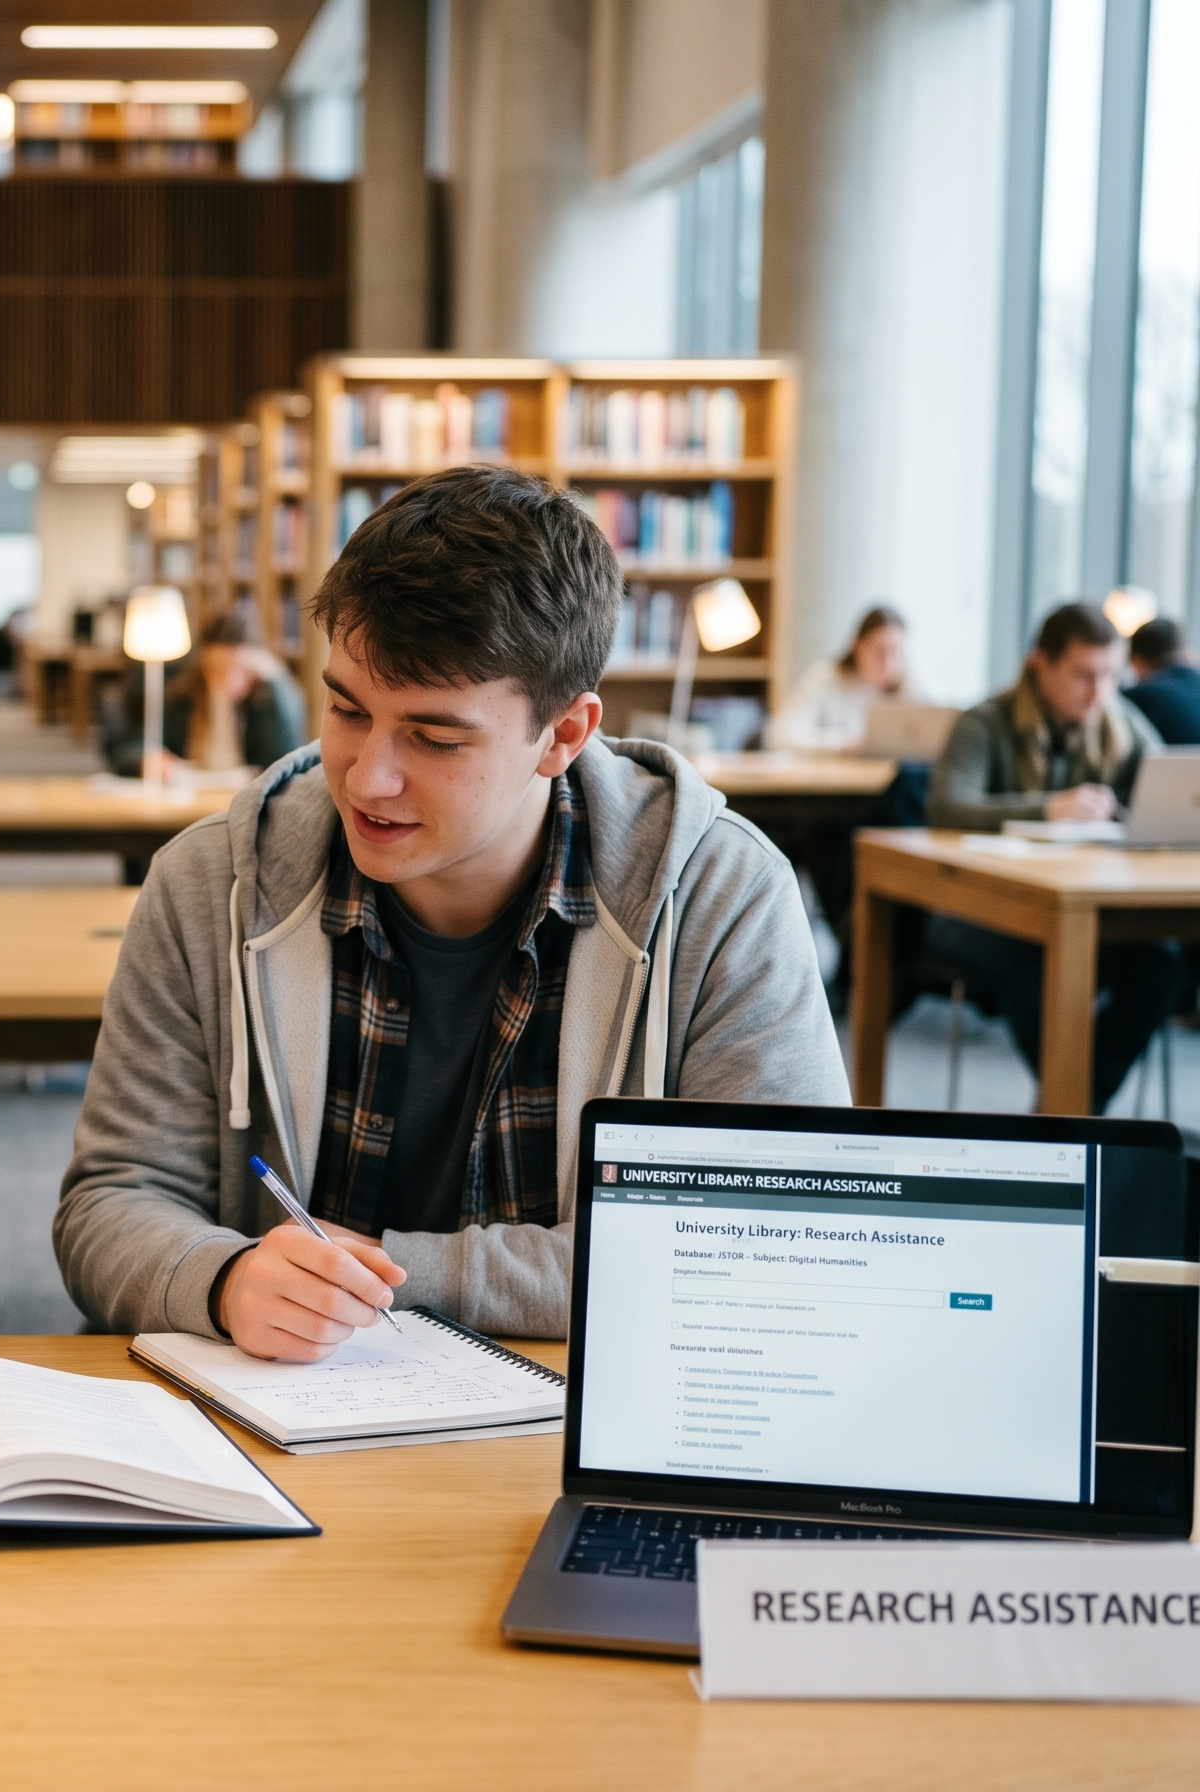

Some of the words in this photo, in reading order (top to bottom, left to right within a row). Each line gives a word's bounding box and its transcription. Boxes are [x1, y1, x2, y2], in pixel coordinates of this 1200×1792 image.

[622, 1169, 697, 1185] UNIVERSITY
[697, 1172, 753, 1188] LIBRARY:
[755, 1175, 822, 1191] RESEARCH
[823, 1178, 902, 1195] ASSISTANCE
[675, 1220, 745, 1239] University
[748, 1224, 801, 1242] Library:
[805, 1227, 867, 1242] Research
[870, 1230, 945, 1246] Assistance
[674, 1249, 715, 1260] Database:
[717, 1250, 744, 1260] JSTOR
[752, 1253, 787, 1264] Subject:
[788, 1254, 817, 1266] Digital
[818, 1256, 868, 1267] Humanities
[752, 1590, 955, 1625] RESEARCH
[967, 1592, 1200, 1626] ASSISTANCE
